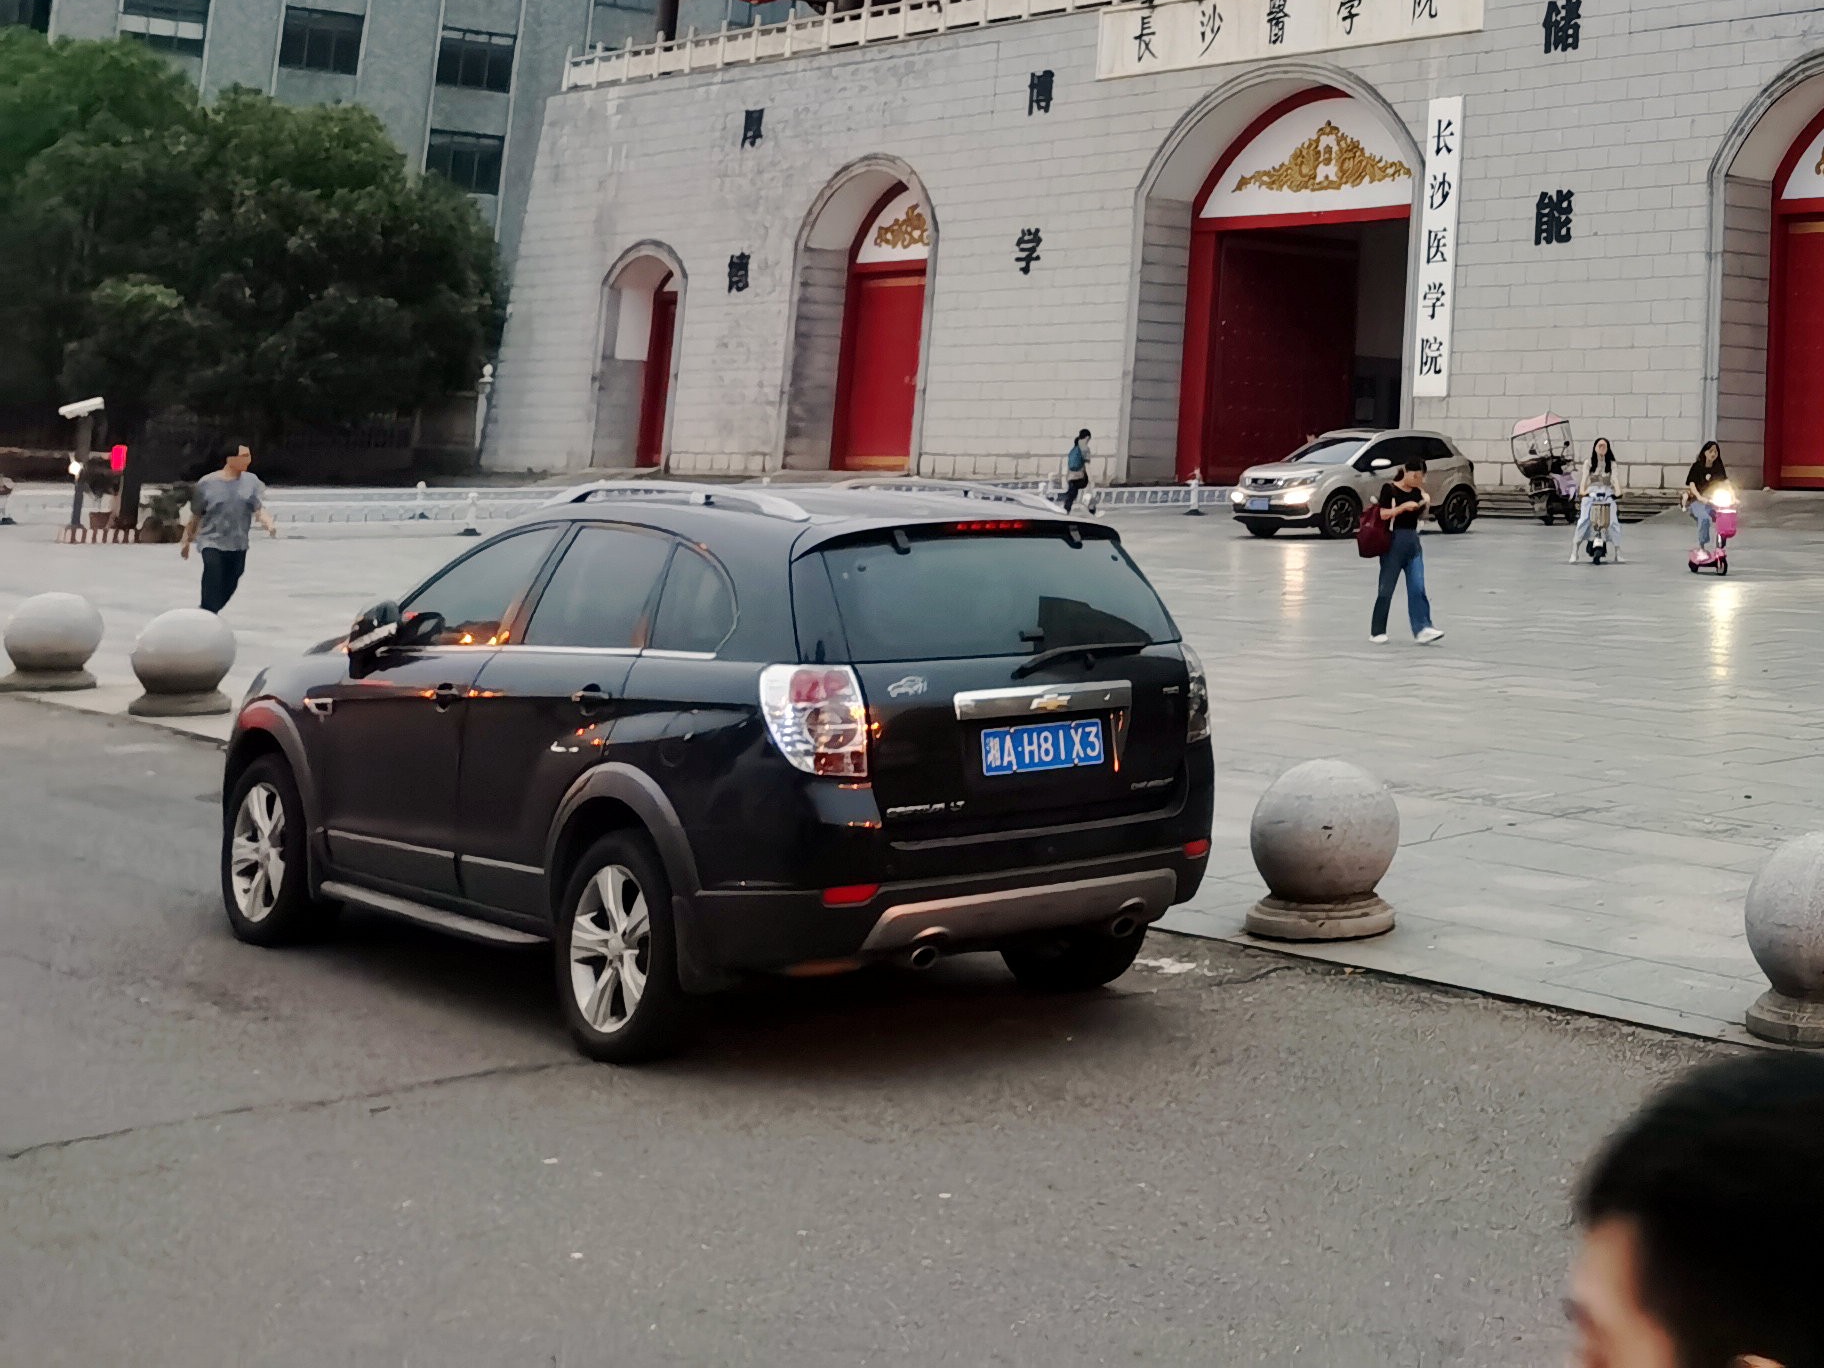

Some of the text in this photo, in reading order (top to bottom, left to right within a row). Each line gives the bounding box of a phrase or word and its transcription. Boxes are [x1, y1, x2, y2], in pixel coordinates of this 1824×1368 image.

[1418, 119, 1456, 379] 长沙医学院
